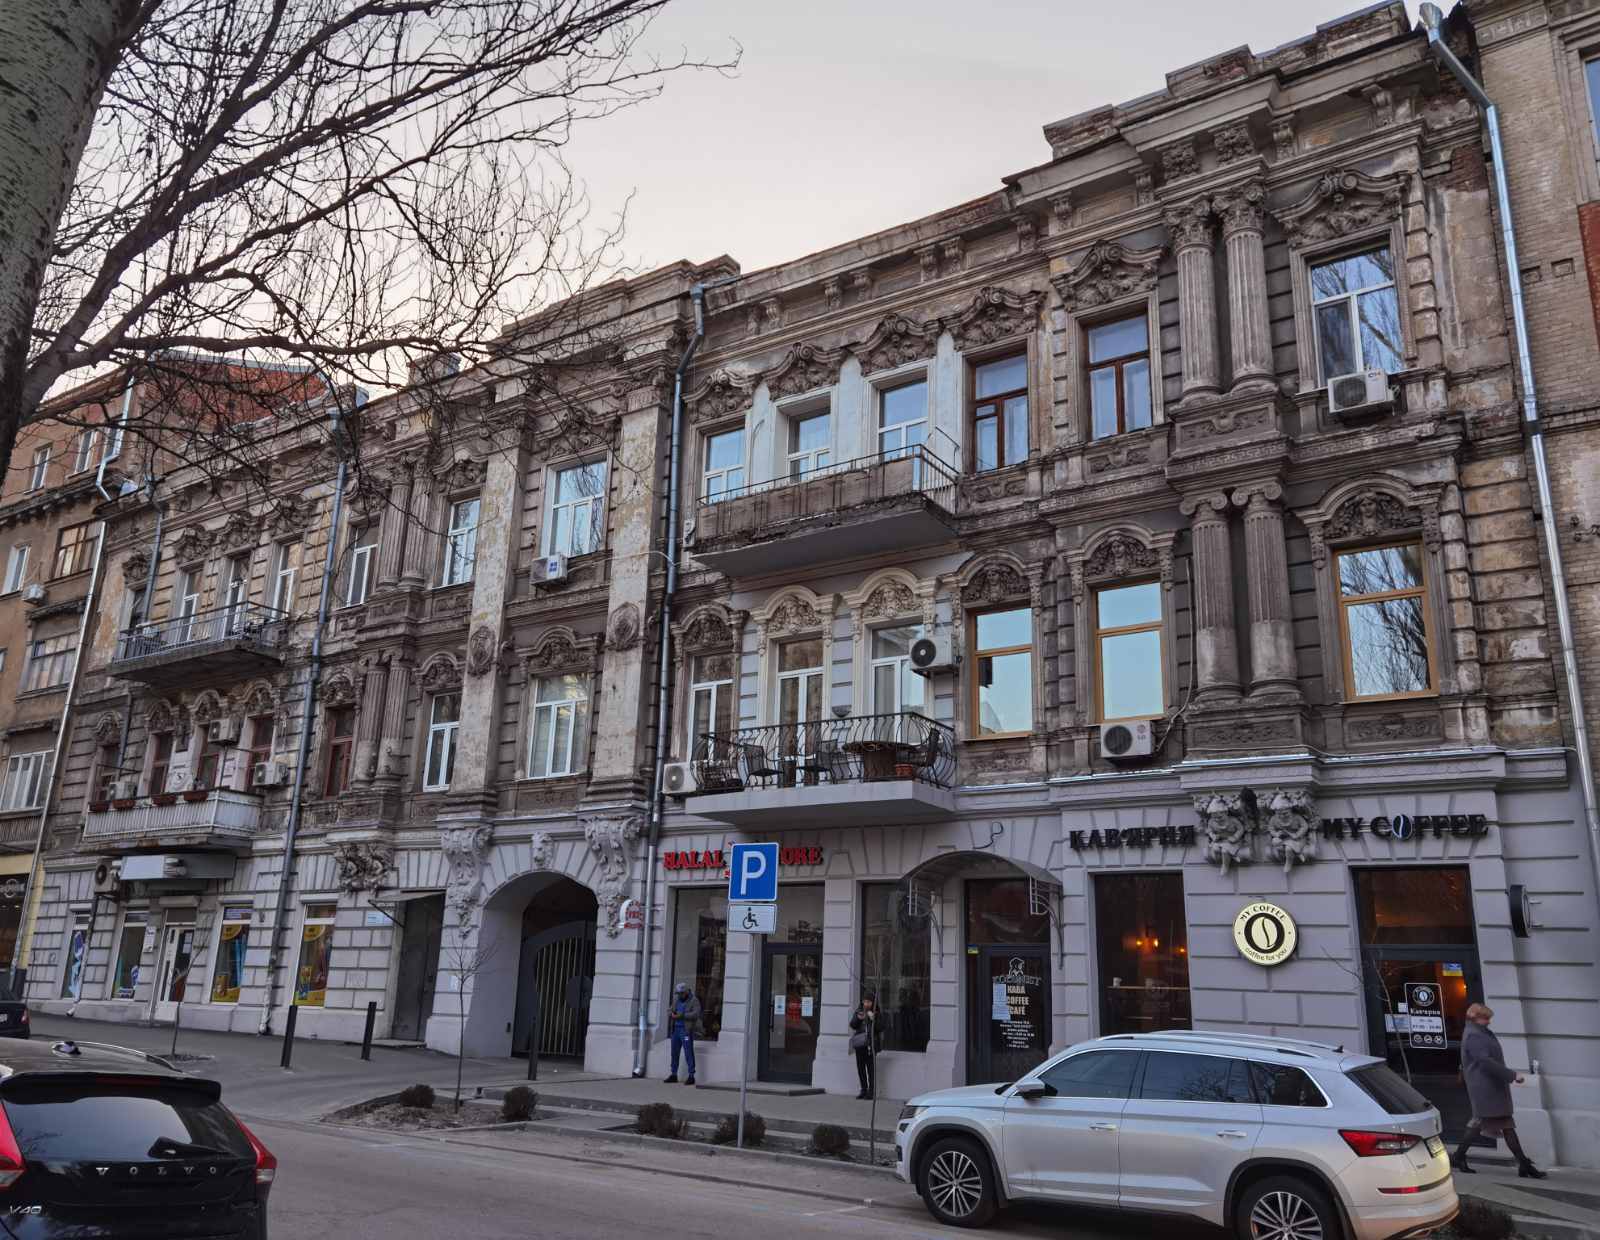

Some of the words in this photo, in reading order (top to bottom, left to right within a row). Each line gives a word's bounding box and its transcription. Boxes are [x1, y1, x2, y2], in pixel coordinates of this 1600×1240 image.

[1321, 817, 1364, 840] MY
[1370, 814, 1489, 840] COFFEE
[663, 850, 725, 869] HALAL
[778, 847, 824, 865] ORE
[740, 850, 767, 896] P
[1240, 911, 1250, 920] MY
[1253, 905, 1286, 920] COFFEE
[95, 1166, 217, 1176] VOLVO
[9, 1205, 42, 1215] V40
